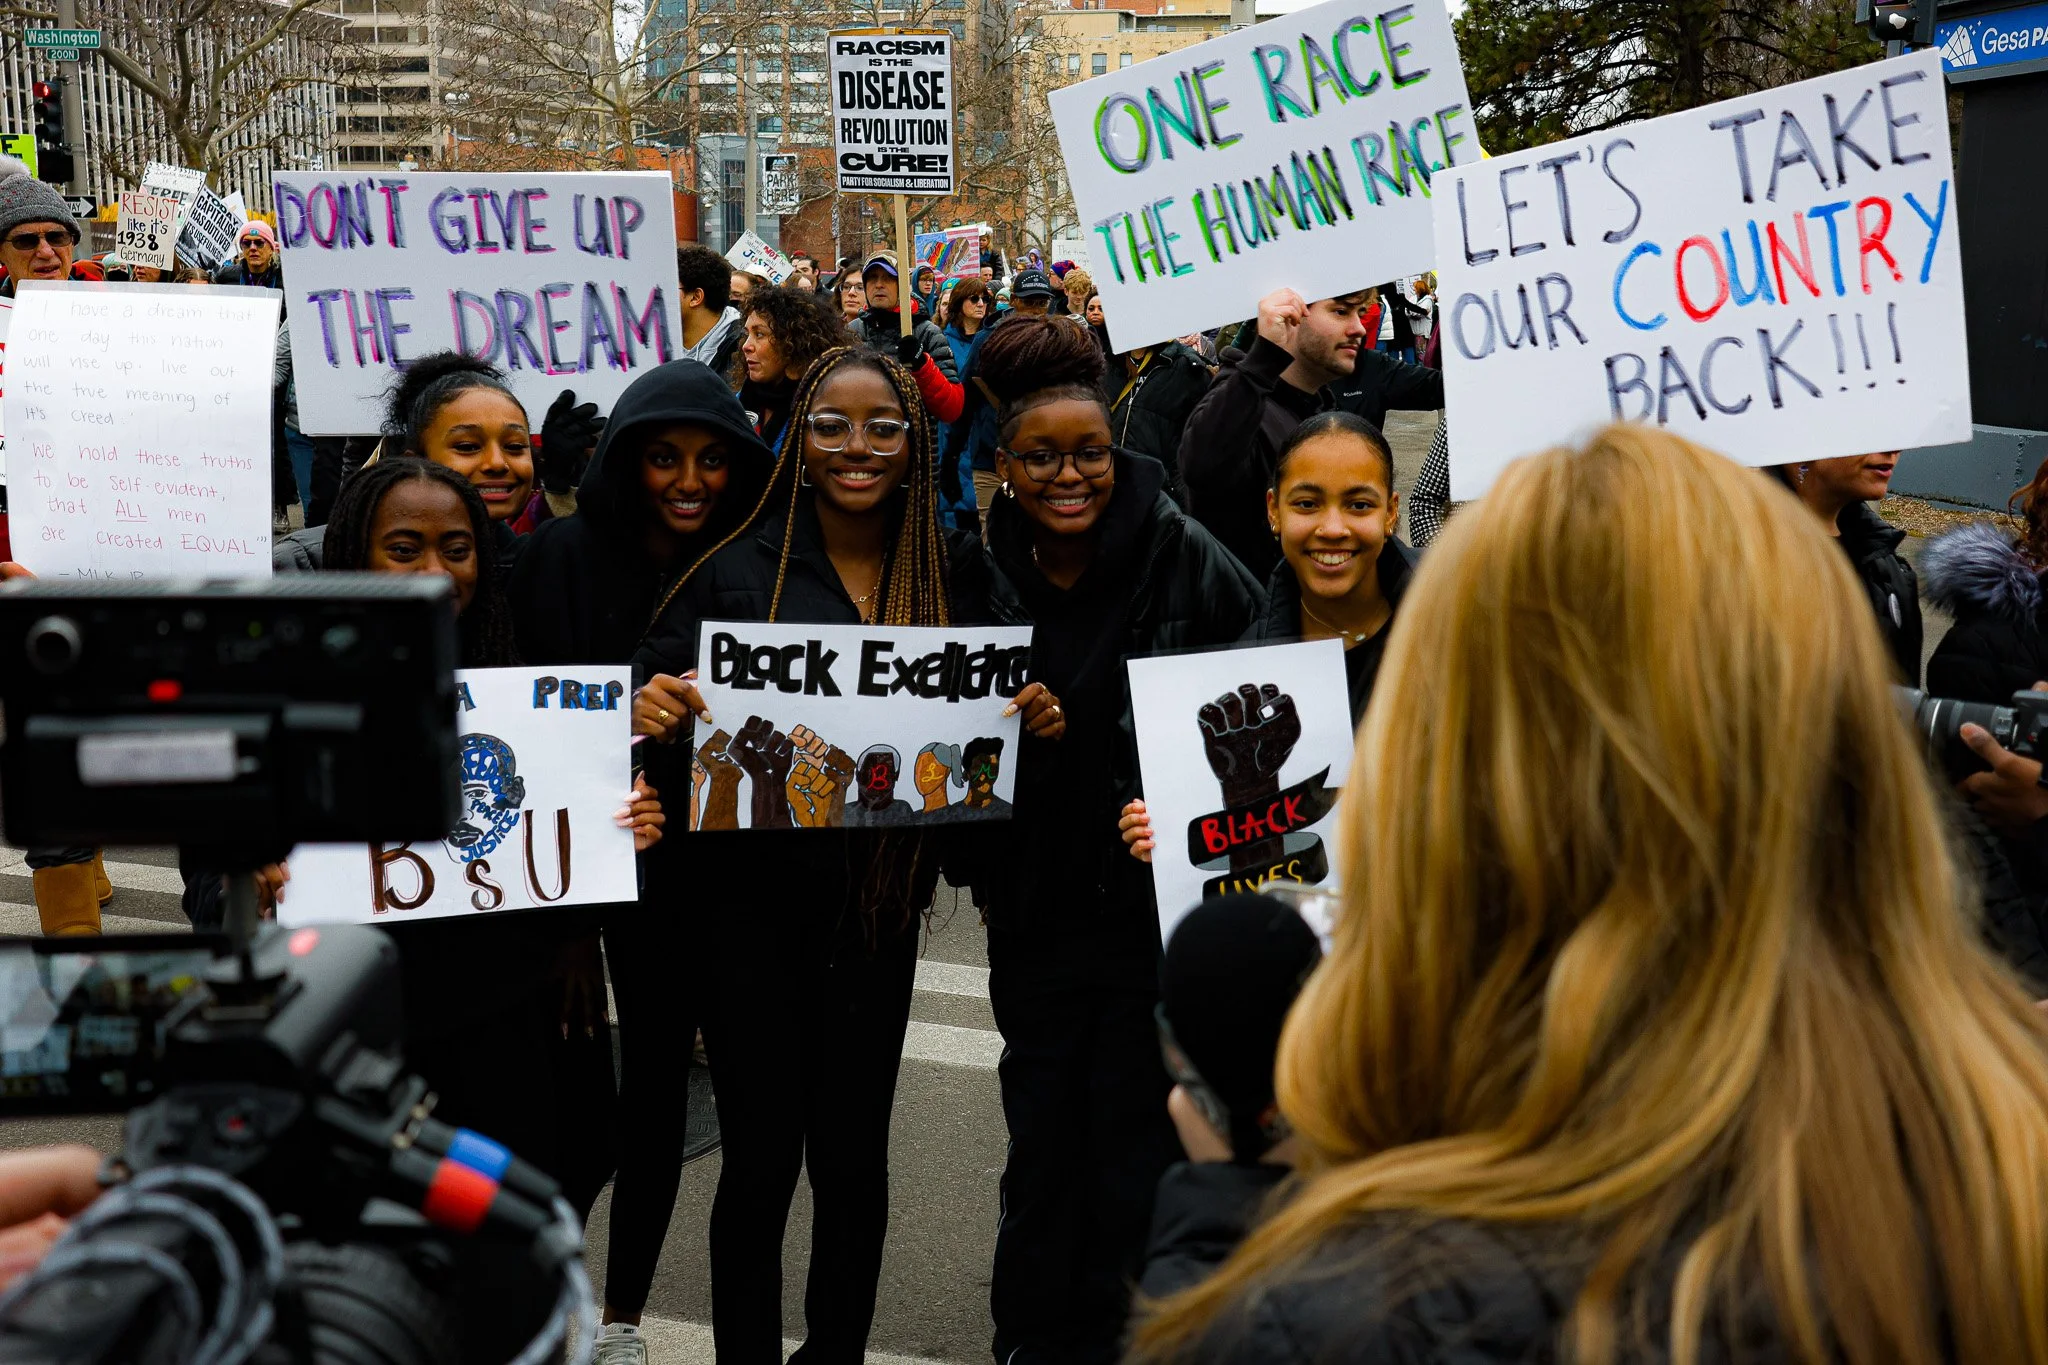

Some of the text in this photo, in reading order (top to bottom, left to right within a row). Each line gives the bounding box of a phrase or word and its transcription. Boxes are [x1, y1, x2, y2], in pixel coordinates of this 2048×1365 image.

[27, 30, 98, 47] Washington
[836, 41, 945, 56] RACISM
[1982, 27, 2029, 54] Gesa
[51, 50, 75, 59] 200N
[869, 59, 912, 67] IS THE
[838, 70, 946, 110] DISEASE
[1094, 4, 1431, 175] ONE RACE
[841, 118, 948, 145] REVOLUTION
[840, 153, 949, 173] CURE!
[1456, 70, 1932, 266] LET'S TAKE
[766, 173, 799, 188] PARK
[842, 176, 949, 189] PARTY FOR SOCIALISM & LIBERATION
[1093, 103, 1467, 284] THE HUMAN RACE
[122, 193, 178, 221] RESIST
[196, 195, 239, 243] CAPITALISM
[275, 177, 645, 260] DON'T GIVE UP
[127, 218, 168, 234] like it's
[187, 221, 196, 236] ITS
[190, 208, 206, 227] HAS
[203, 220, 231, 252] OUTLIVED
[117, 230, 159, 251] 1938
[763, 245, 780, 260] NOT
[120, 246, 165, 268] Germany
[743, 249, 783, 284] JUSTICE
[1450, 180, 1949, 360] OUR COUNTRY
[71, 301, 111, 318] have
[123, 304, 134, 318] a
[147, 302, 202, 318] dream
[217, 305, 254, 322] that
[28, 327, 224, 352] one day this nation
[307, 280, 673, 376] THE DREAM
[24, 355, 50, 369] will
[161, 358, 188, 374] live
[210, 366, 240, 379] out
[1604, 302, 1907, 423] BACK!!!
[24, 381, 53, 396] the
[126, 387, 196, 412] meaning
[214, 391, 231, 405] of
[78, 444, 119, 461] hold
[136, 448, 181, 467] these
[201, 452, 253, 471] truths
[33, 470, 51, 488] to
[68, 473, 89, 488] be
[47, 495, 206, 524] that ALL men
[41, 525, 66, 542] are
[97, 529, 163, 550] created
[533, 675, 624, 711] PREP
[867, 763, 890, 791] B
[471, 799, 503, 824] PEACE
[1201, 794, 1307, 853] BLACK
[460, 809, 520, 863] JUSTICE
